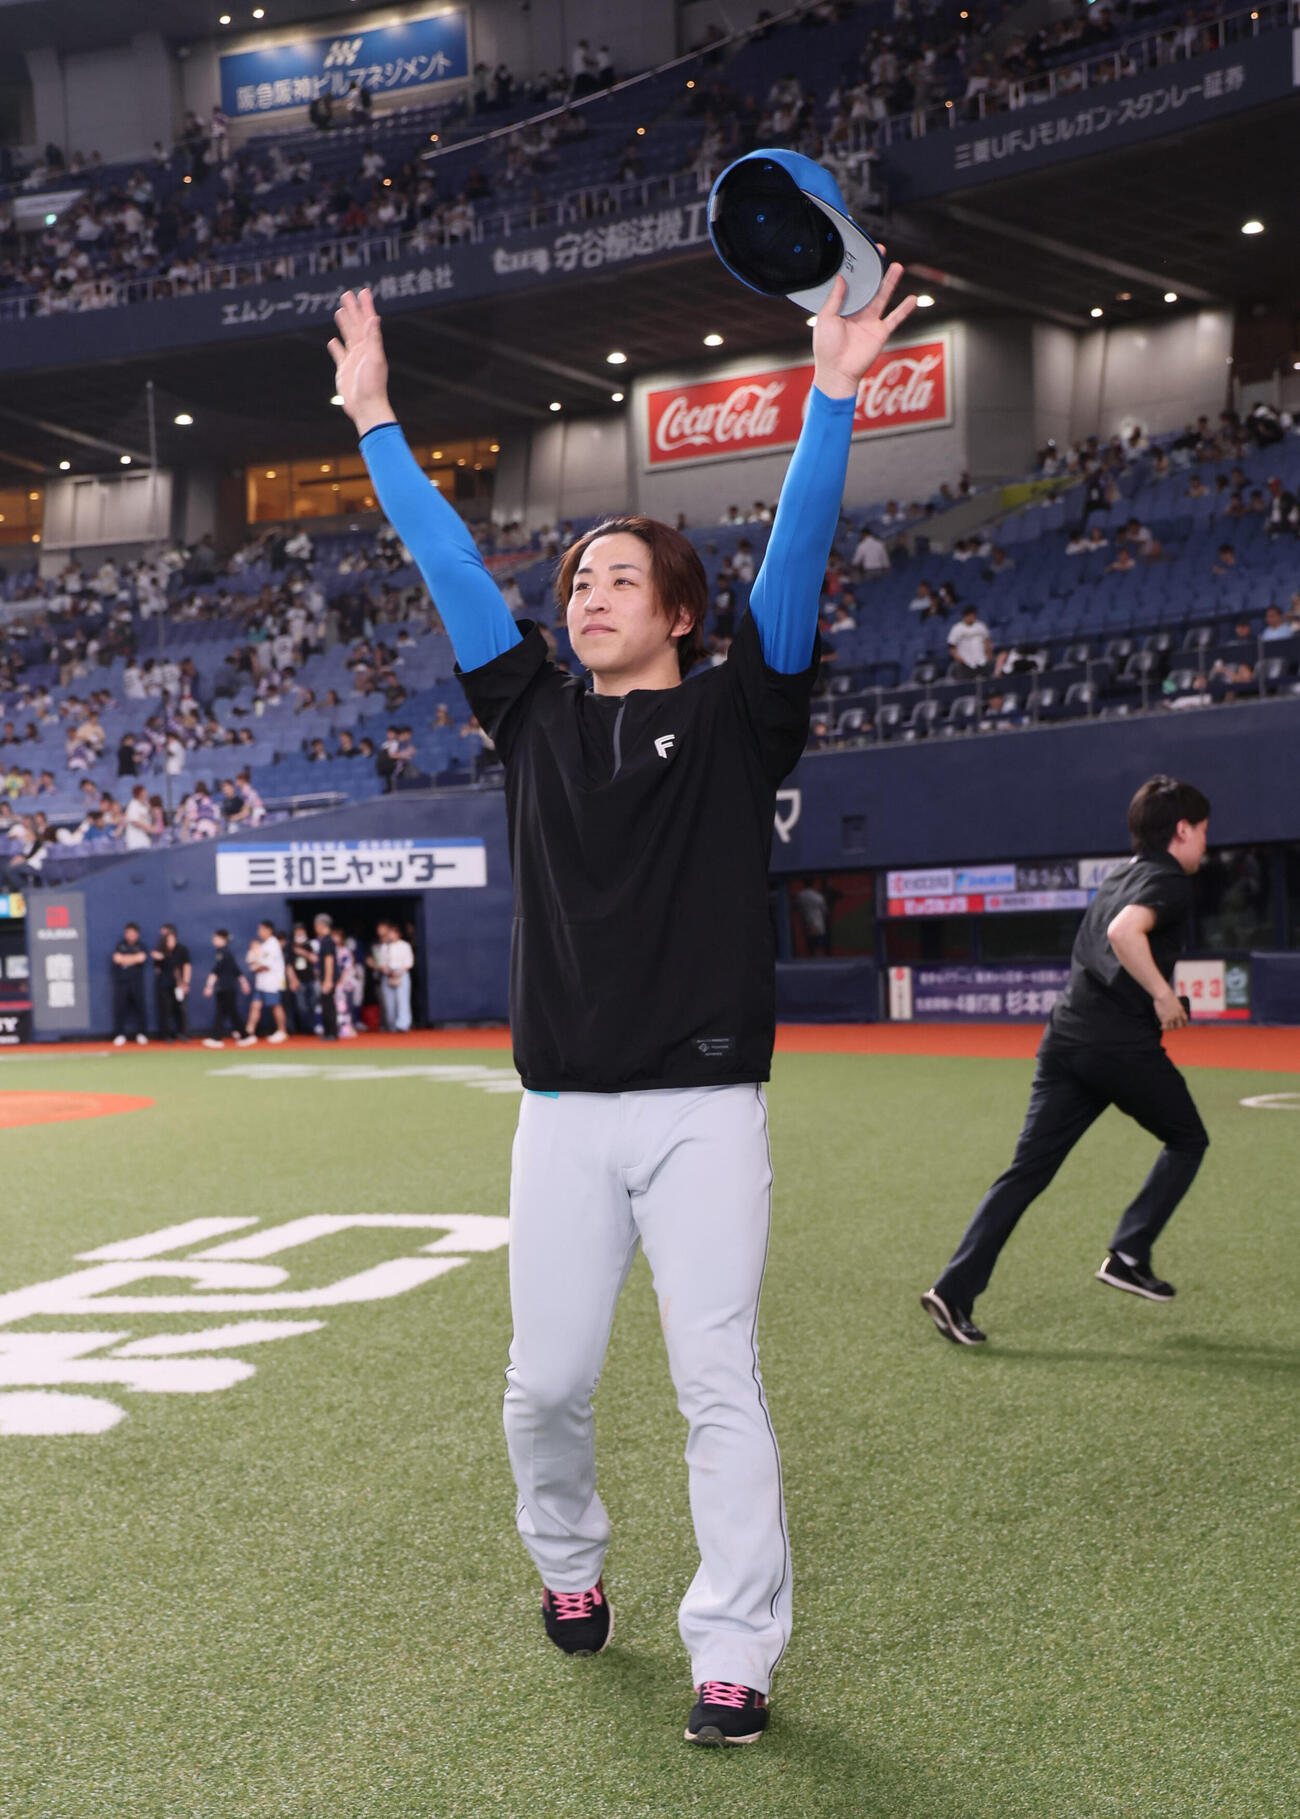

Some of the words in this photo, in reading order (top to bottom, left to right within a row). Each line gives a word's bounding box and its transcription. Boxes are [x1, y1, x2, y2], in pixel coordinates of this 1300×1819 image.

[248, 853, 456, 887] 三和シャッター
